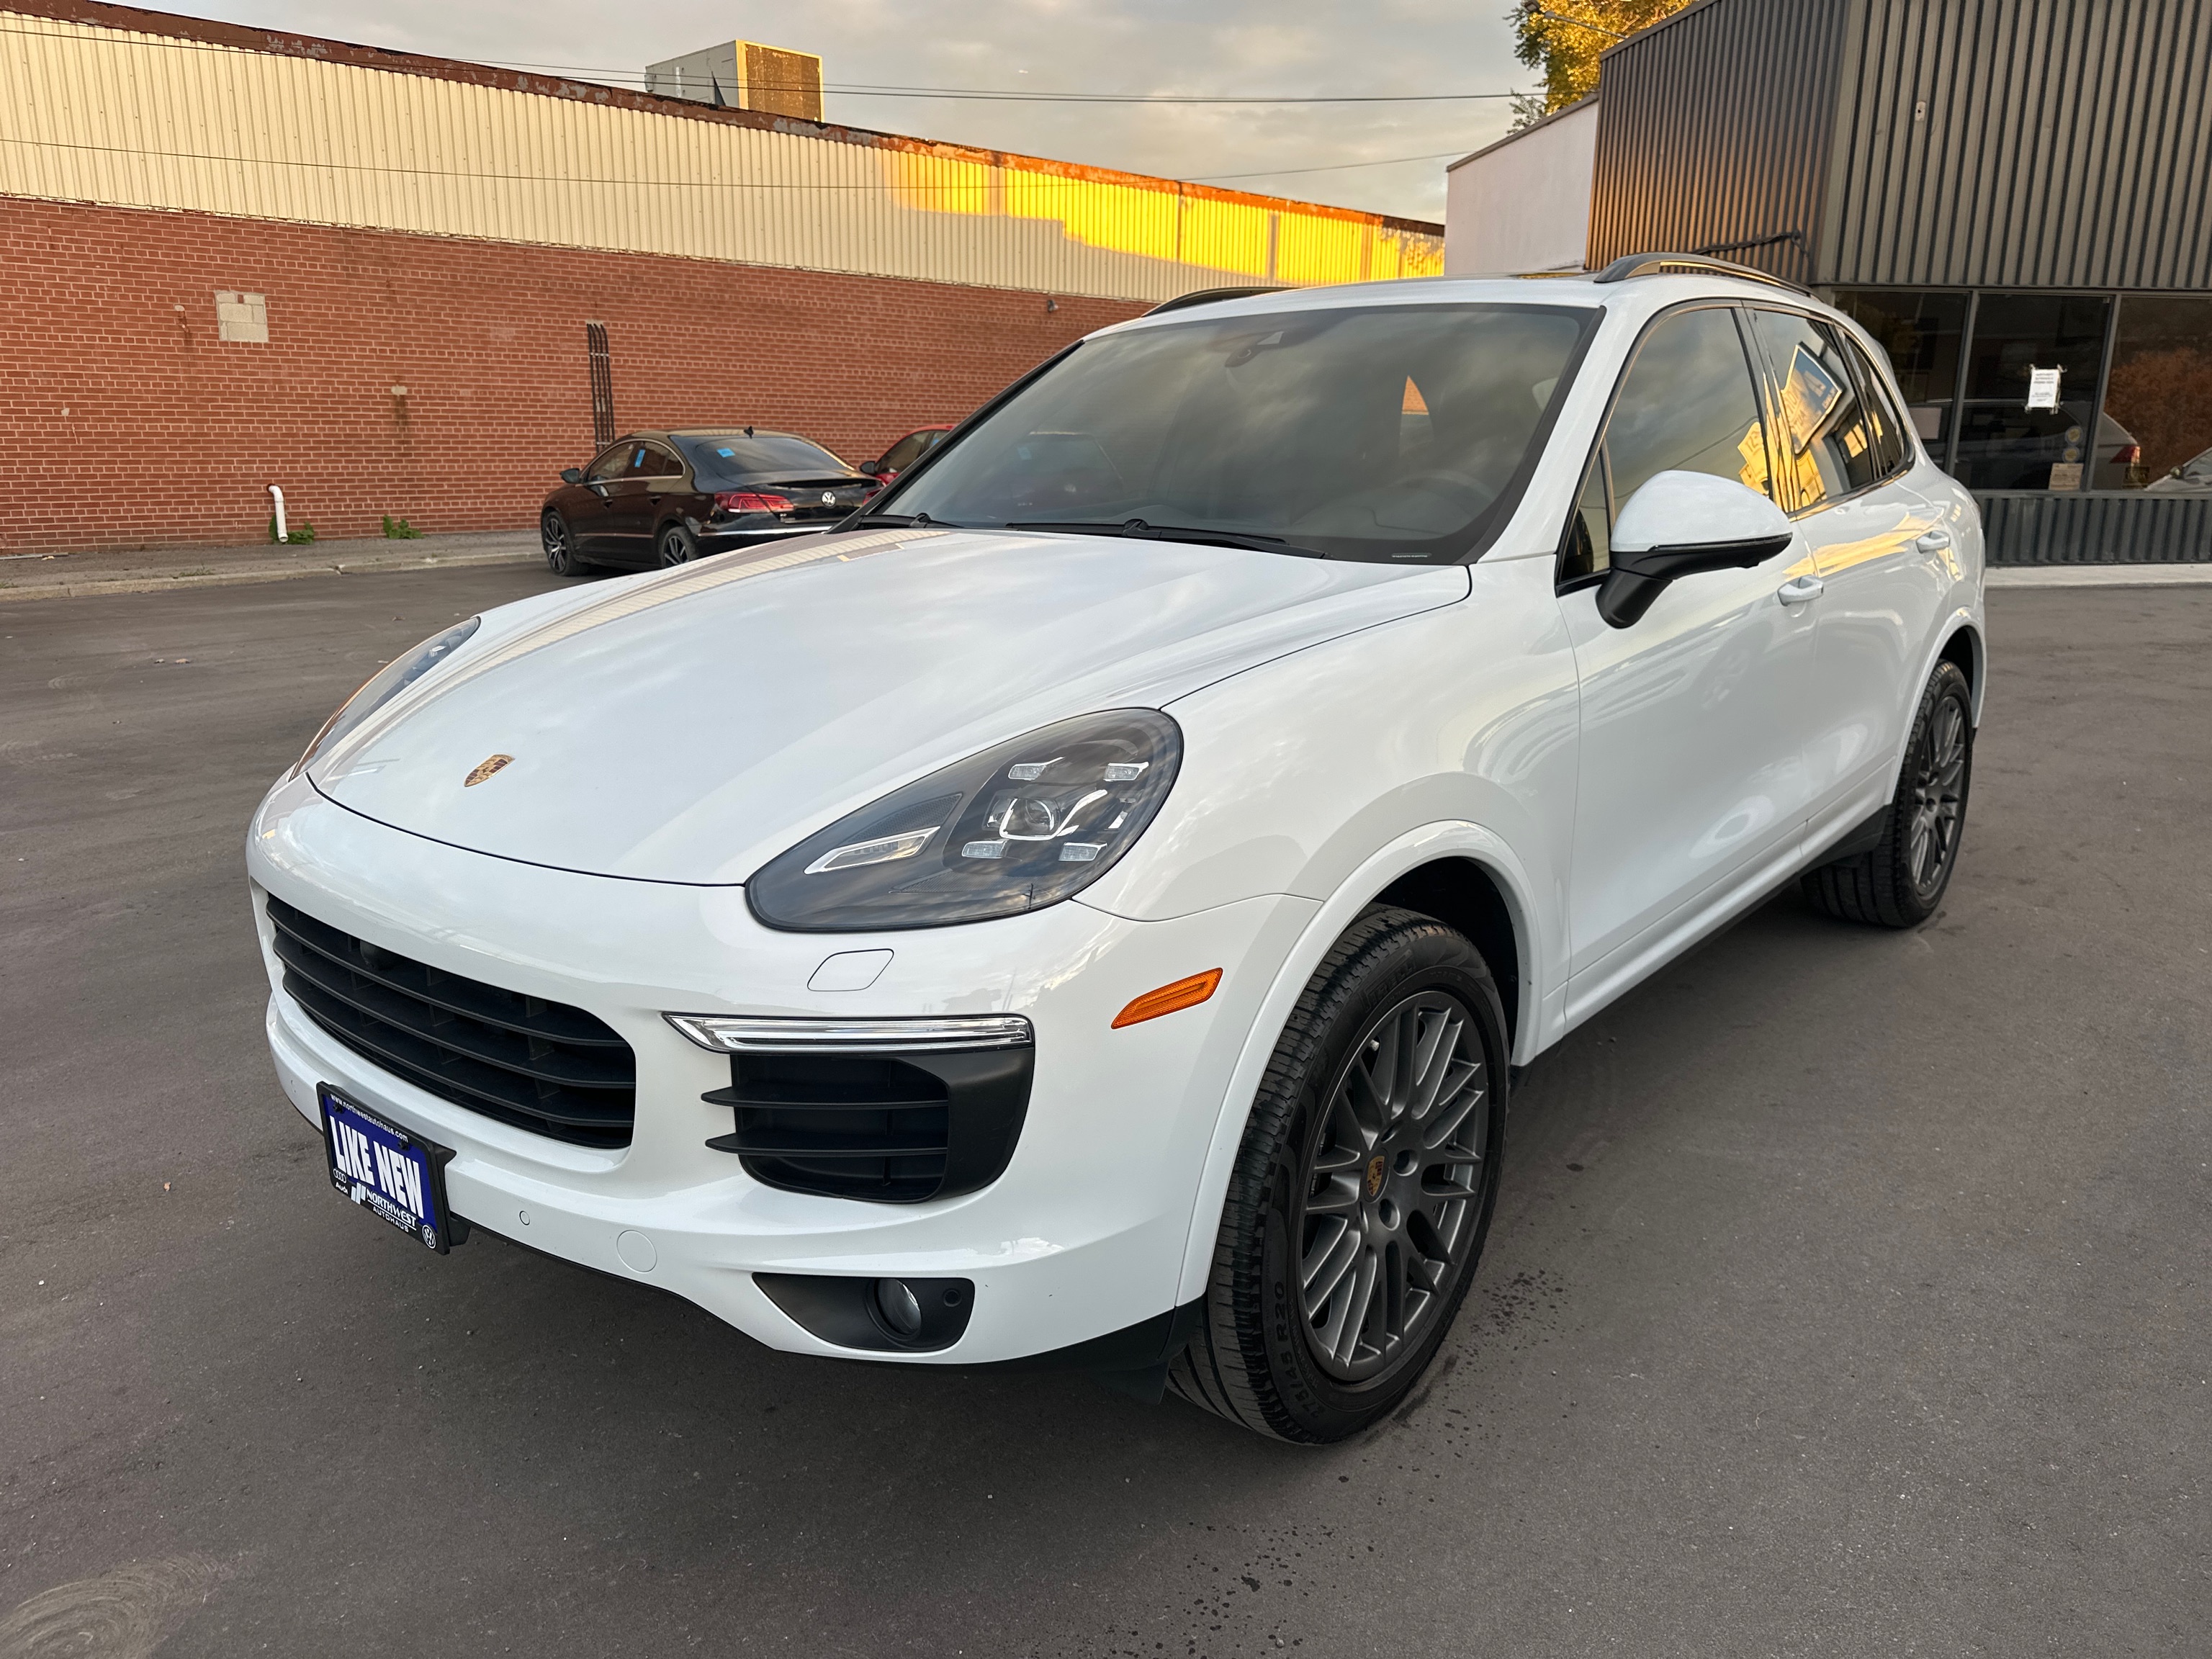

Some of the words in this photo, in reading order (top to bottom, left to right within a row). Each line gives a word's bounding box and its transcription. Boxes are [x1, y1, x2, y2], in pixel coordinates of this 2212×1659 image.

[331, 1094, 409, 1143] www.northwestautohaus.com
[330, 1115, 375, 1186] LIKE
[373, 1141, 424, 1219] NEW
[336, 1182, 349, 1195] Audi
[366, 1188, 417, 1227] NORTHWEST
[373, 1206, 409, 1233] AUTOHAUS
